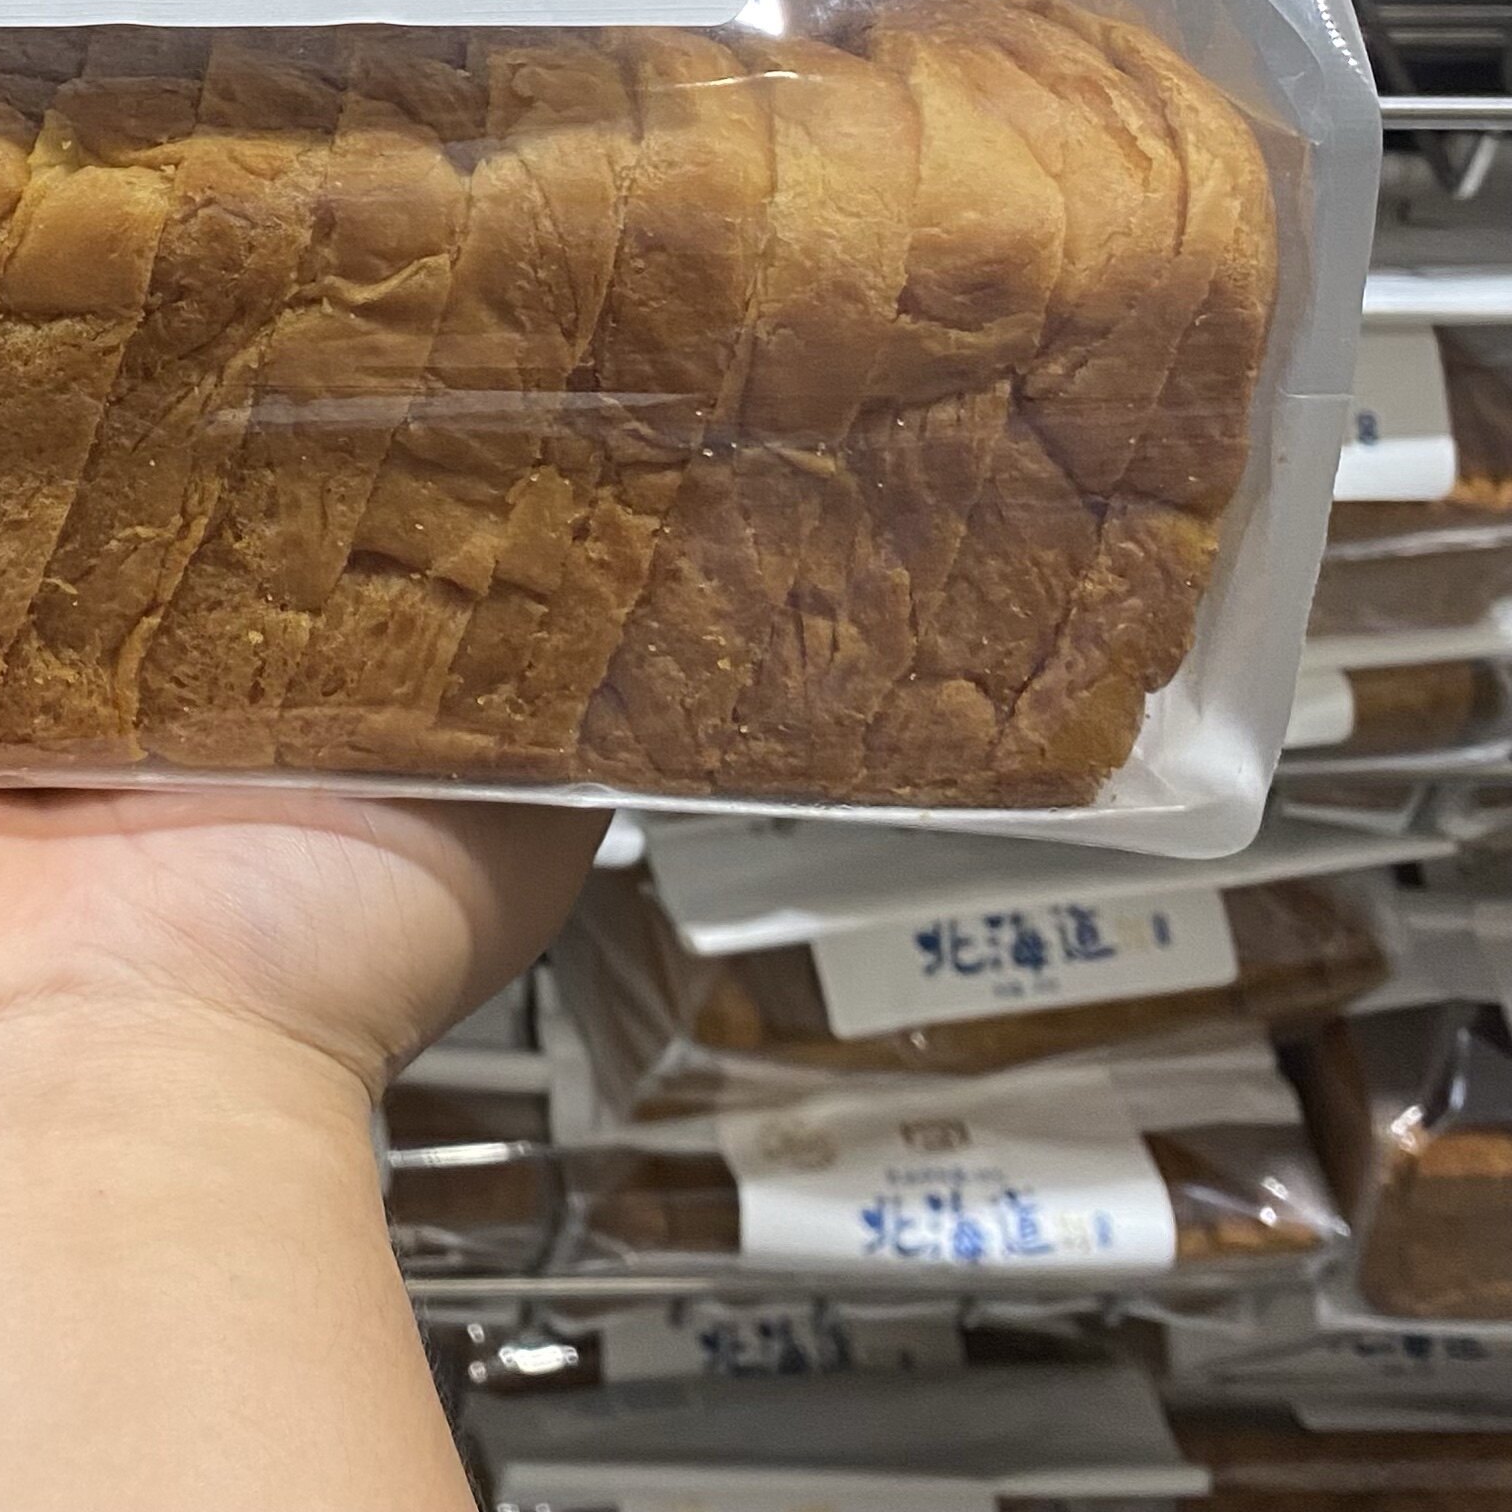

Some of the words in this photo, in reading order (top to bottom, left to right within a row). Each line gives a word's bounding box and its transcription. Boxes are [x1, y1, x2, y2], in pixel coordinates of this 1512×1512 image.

[914, 904, 1118, 976] 北海道
[861, 1185, 1055, 1263] 北海道
